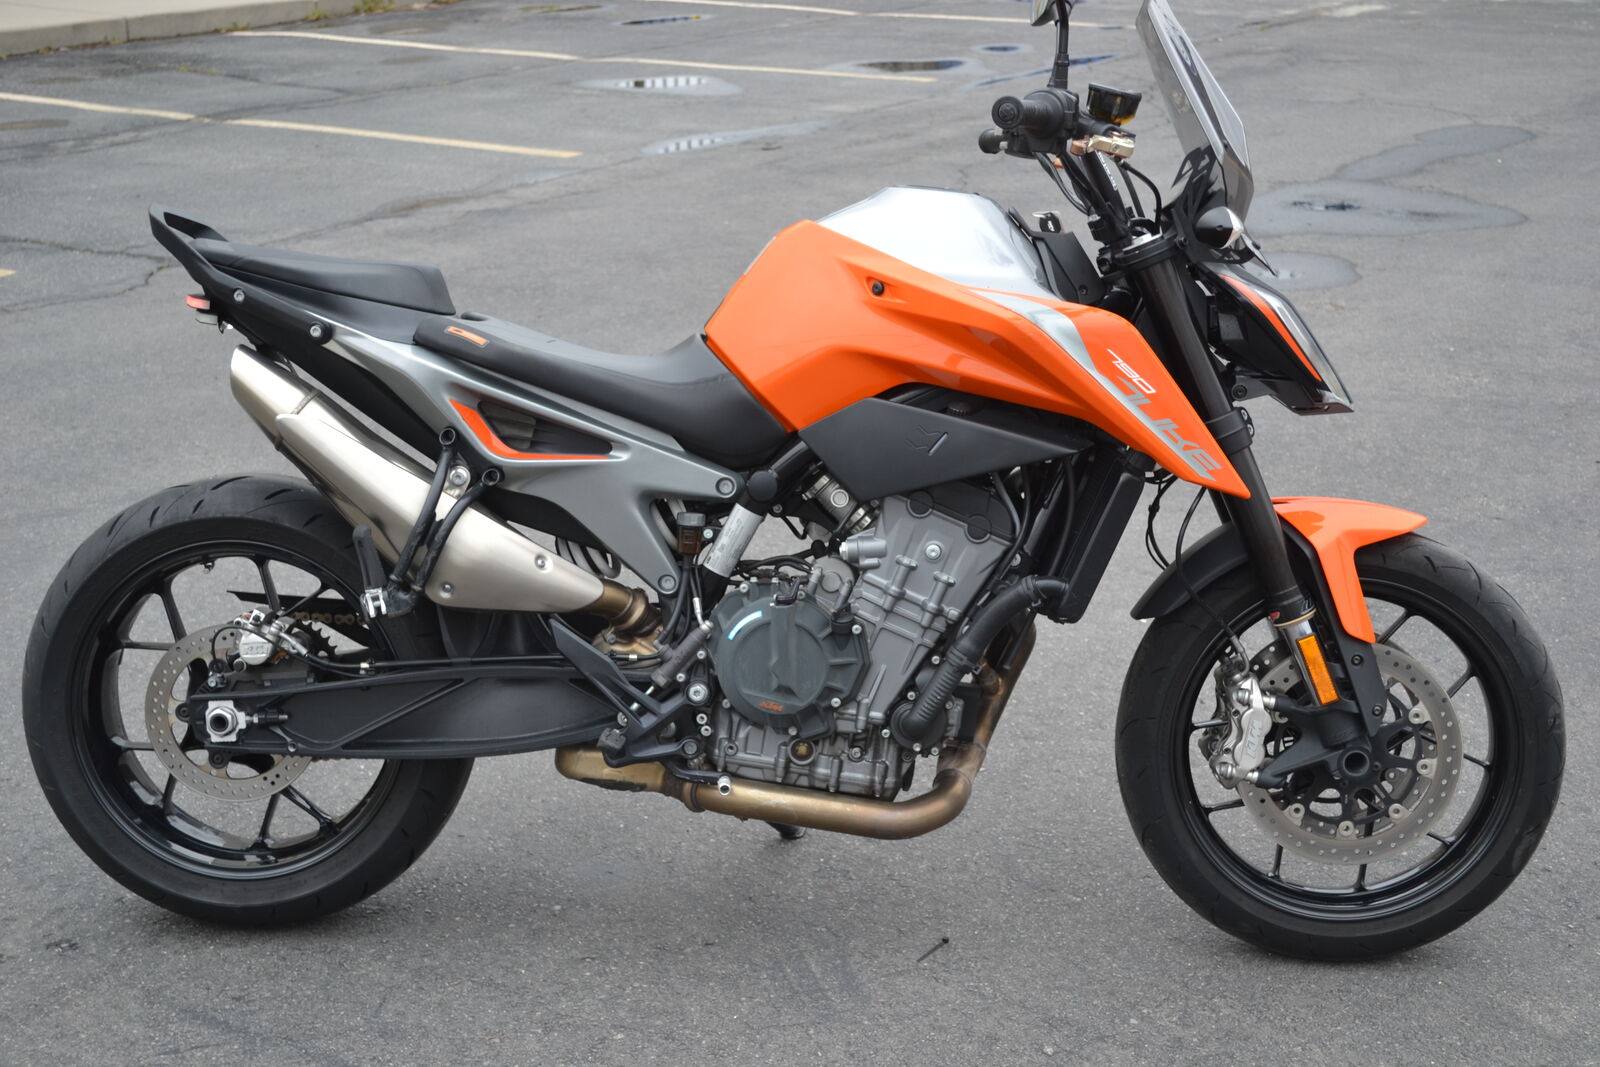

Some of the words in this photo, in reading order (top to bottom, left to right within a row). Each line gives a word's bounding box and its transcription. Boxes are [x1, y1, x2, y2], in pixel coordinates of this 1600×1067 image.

[1106, 348, 1156, 394] 790
[1117, 375, 1223, 481] DUKE
[759, 701, 785, 712] KTM
[1247, 719, 1264, 760] KTM
